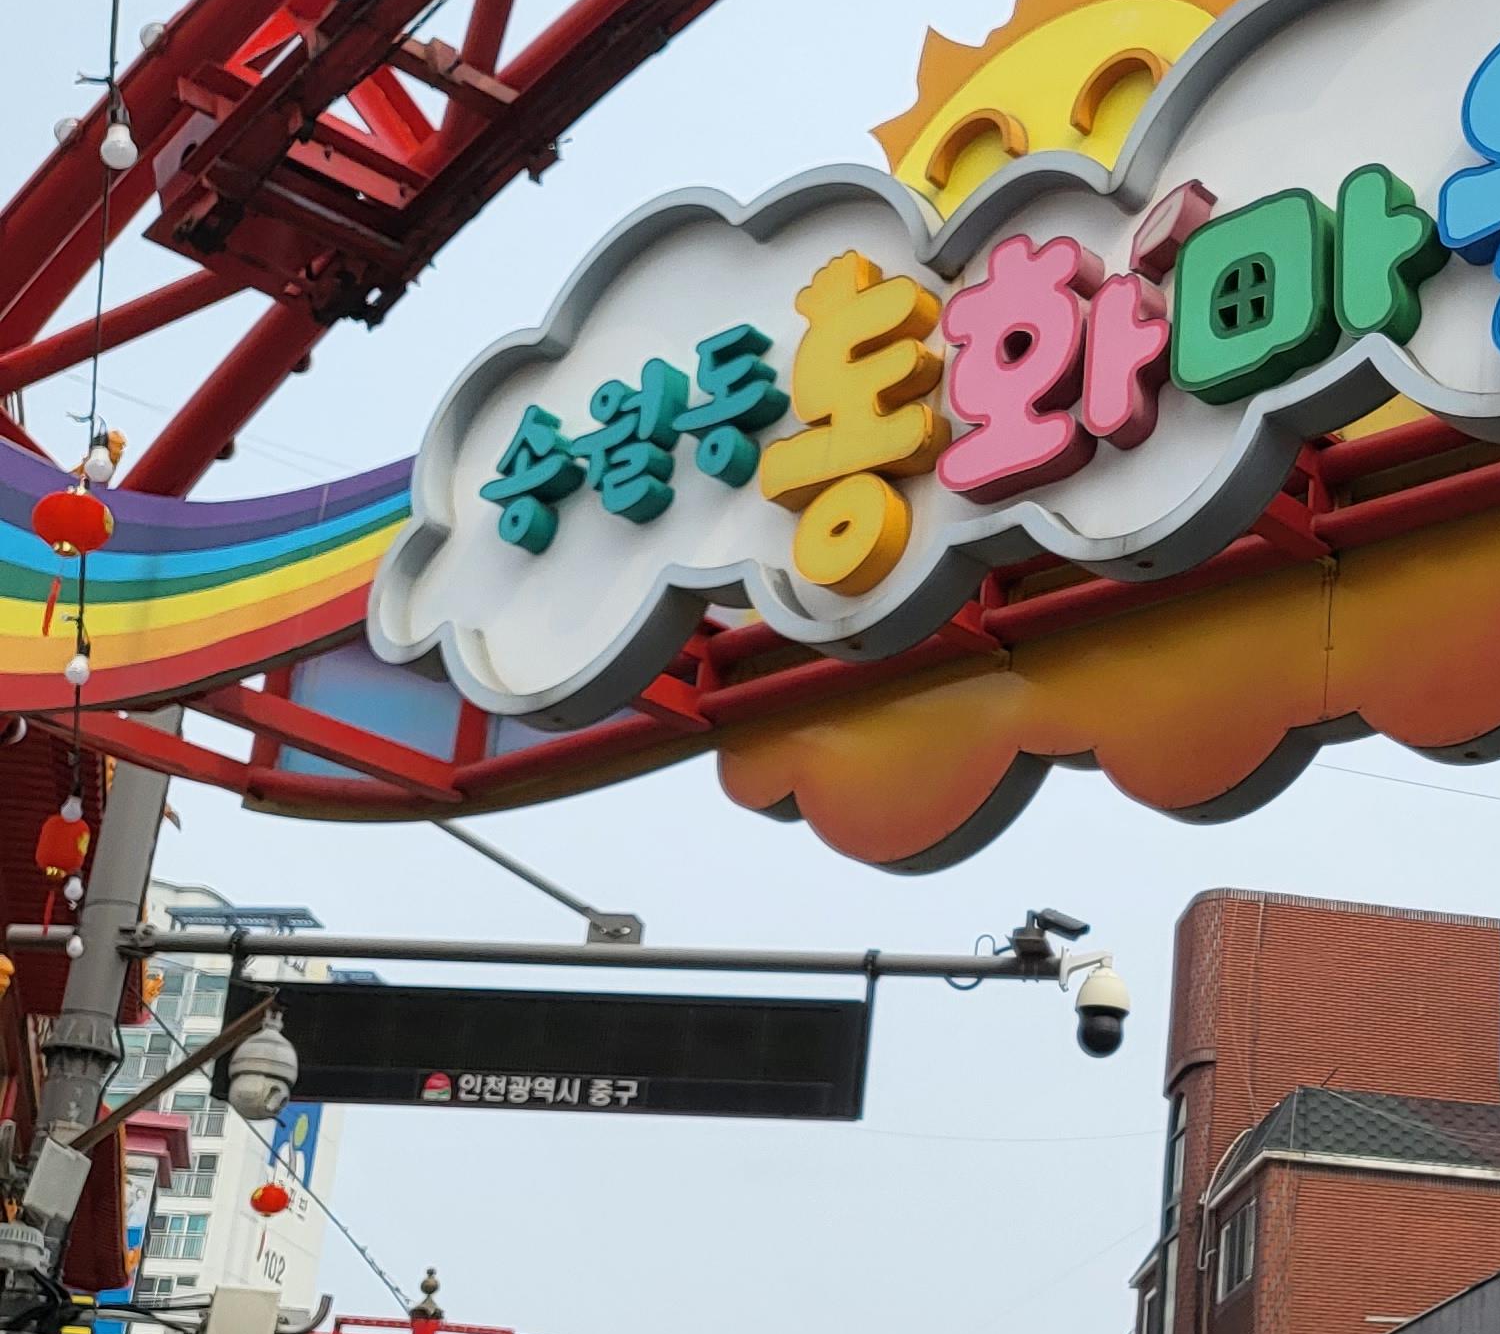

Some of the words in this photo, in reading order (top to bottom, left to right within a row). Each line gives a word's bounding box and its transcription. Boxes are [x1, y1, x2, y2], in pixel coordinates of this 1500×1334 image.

[479, 323, 791, 556] 송월동
[457, 1073, 582, 1104] 인천광역시
[588, 1078, 639, 1107] 중구
[263, 1248, 287, 1285] 102
